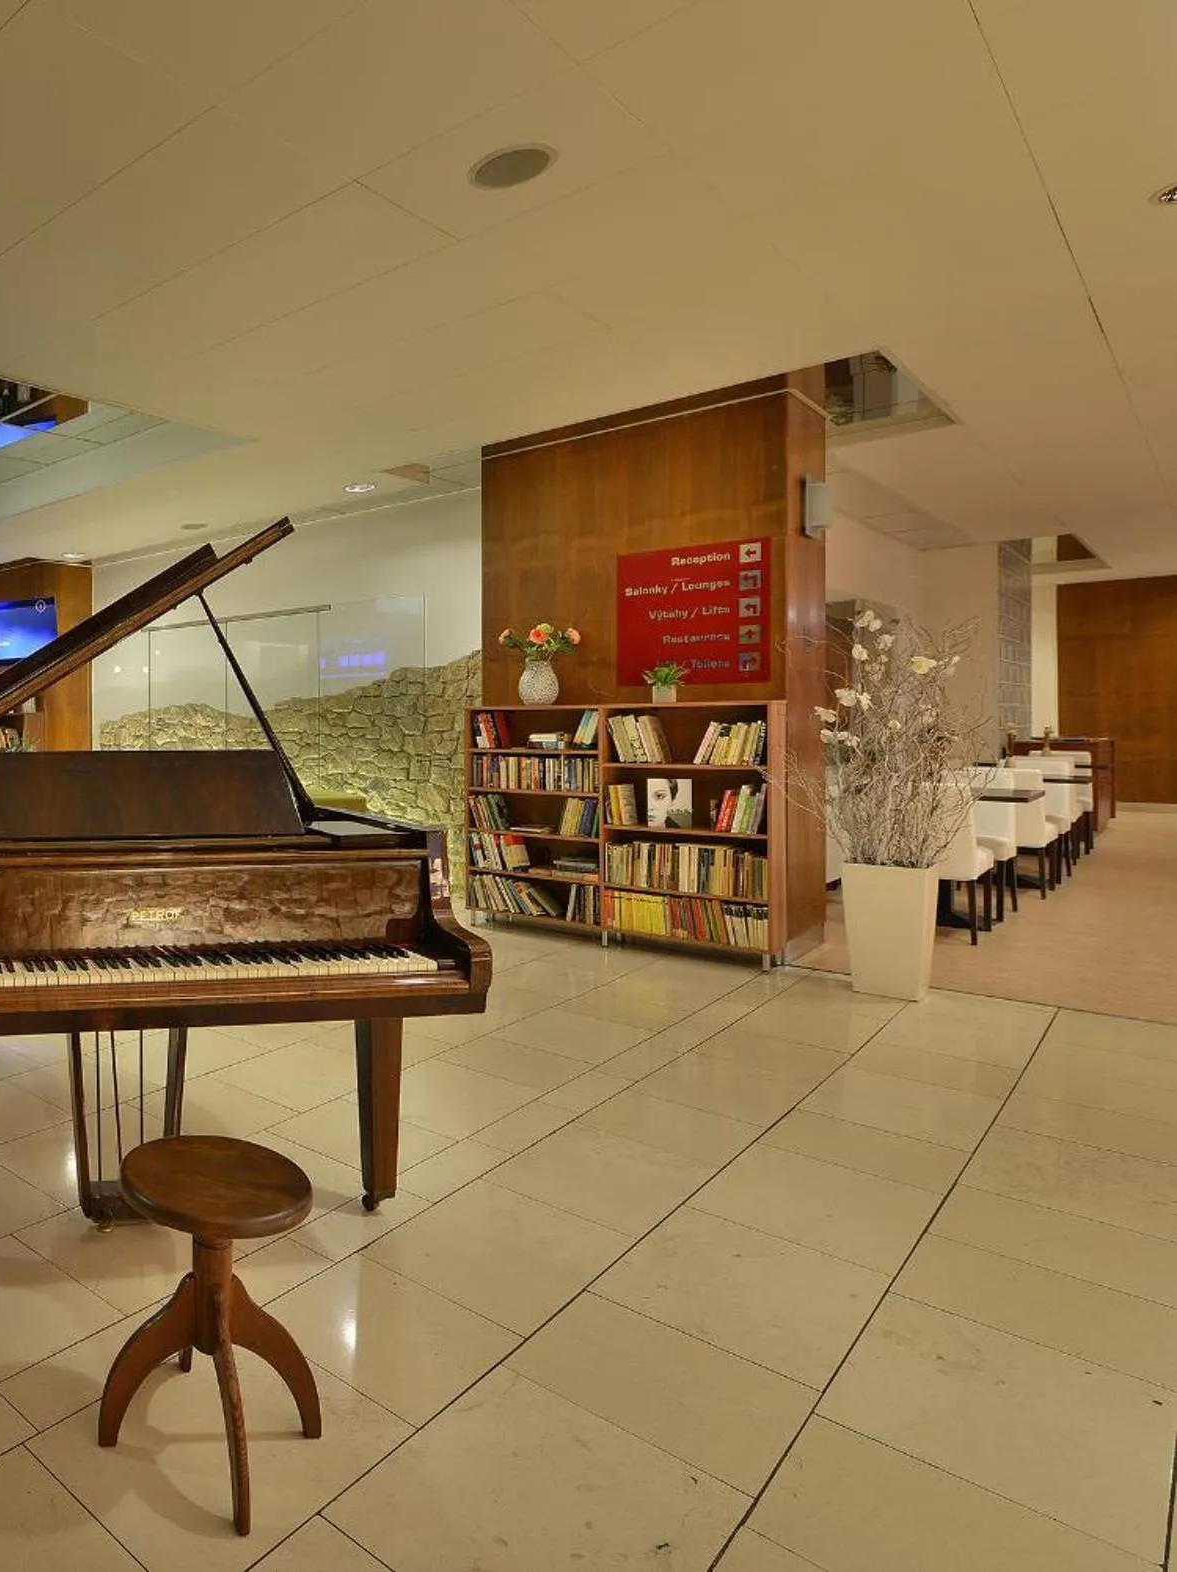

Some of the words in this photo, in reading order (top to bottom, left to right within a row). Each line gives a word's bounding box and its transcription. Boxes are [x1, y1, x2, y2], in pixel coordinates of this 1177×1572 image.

[670, 552, 731, 566] Reception
[625, 584, 668, 597] Salonky
[681, 579, 730, 592] Lounges
[702, 605, 730, 615] Lifts
